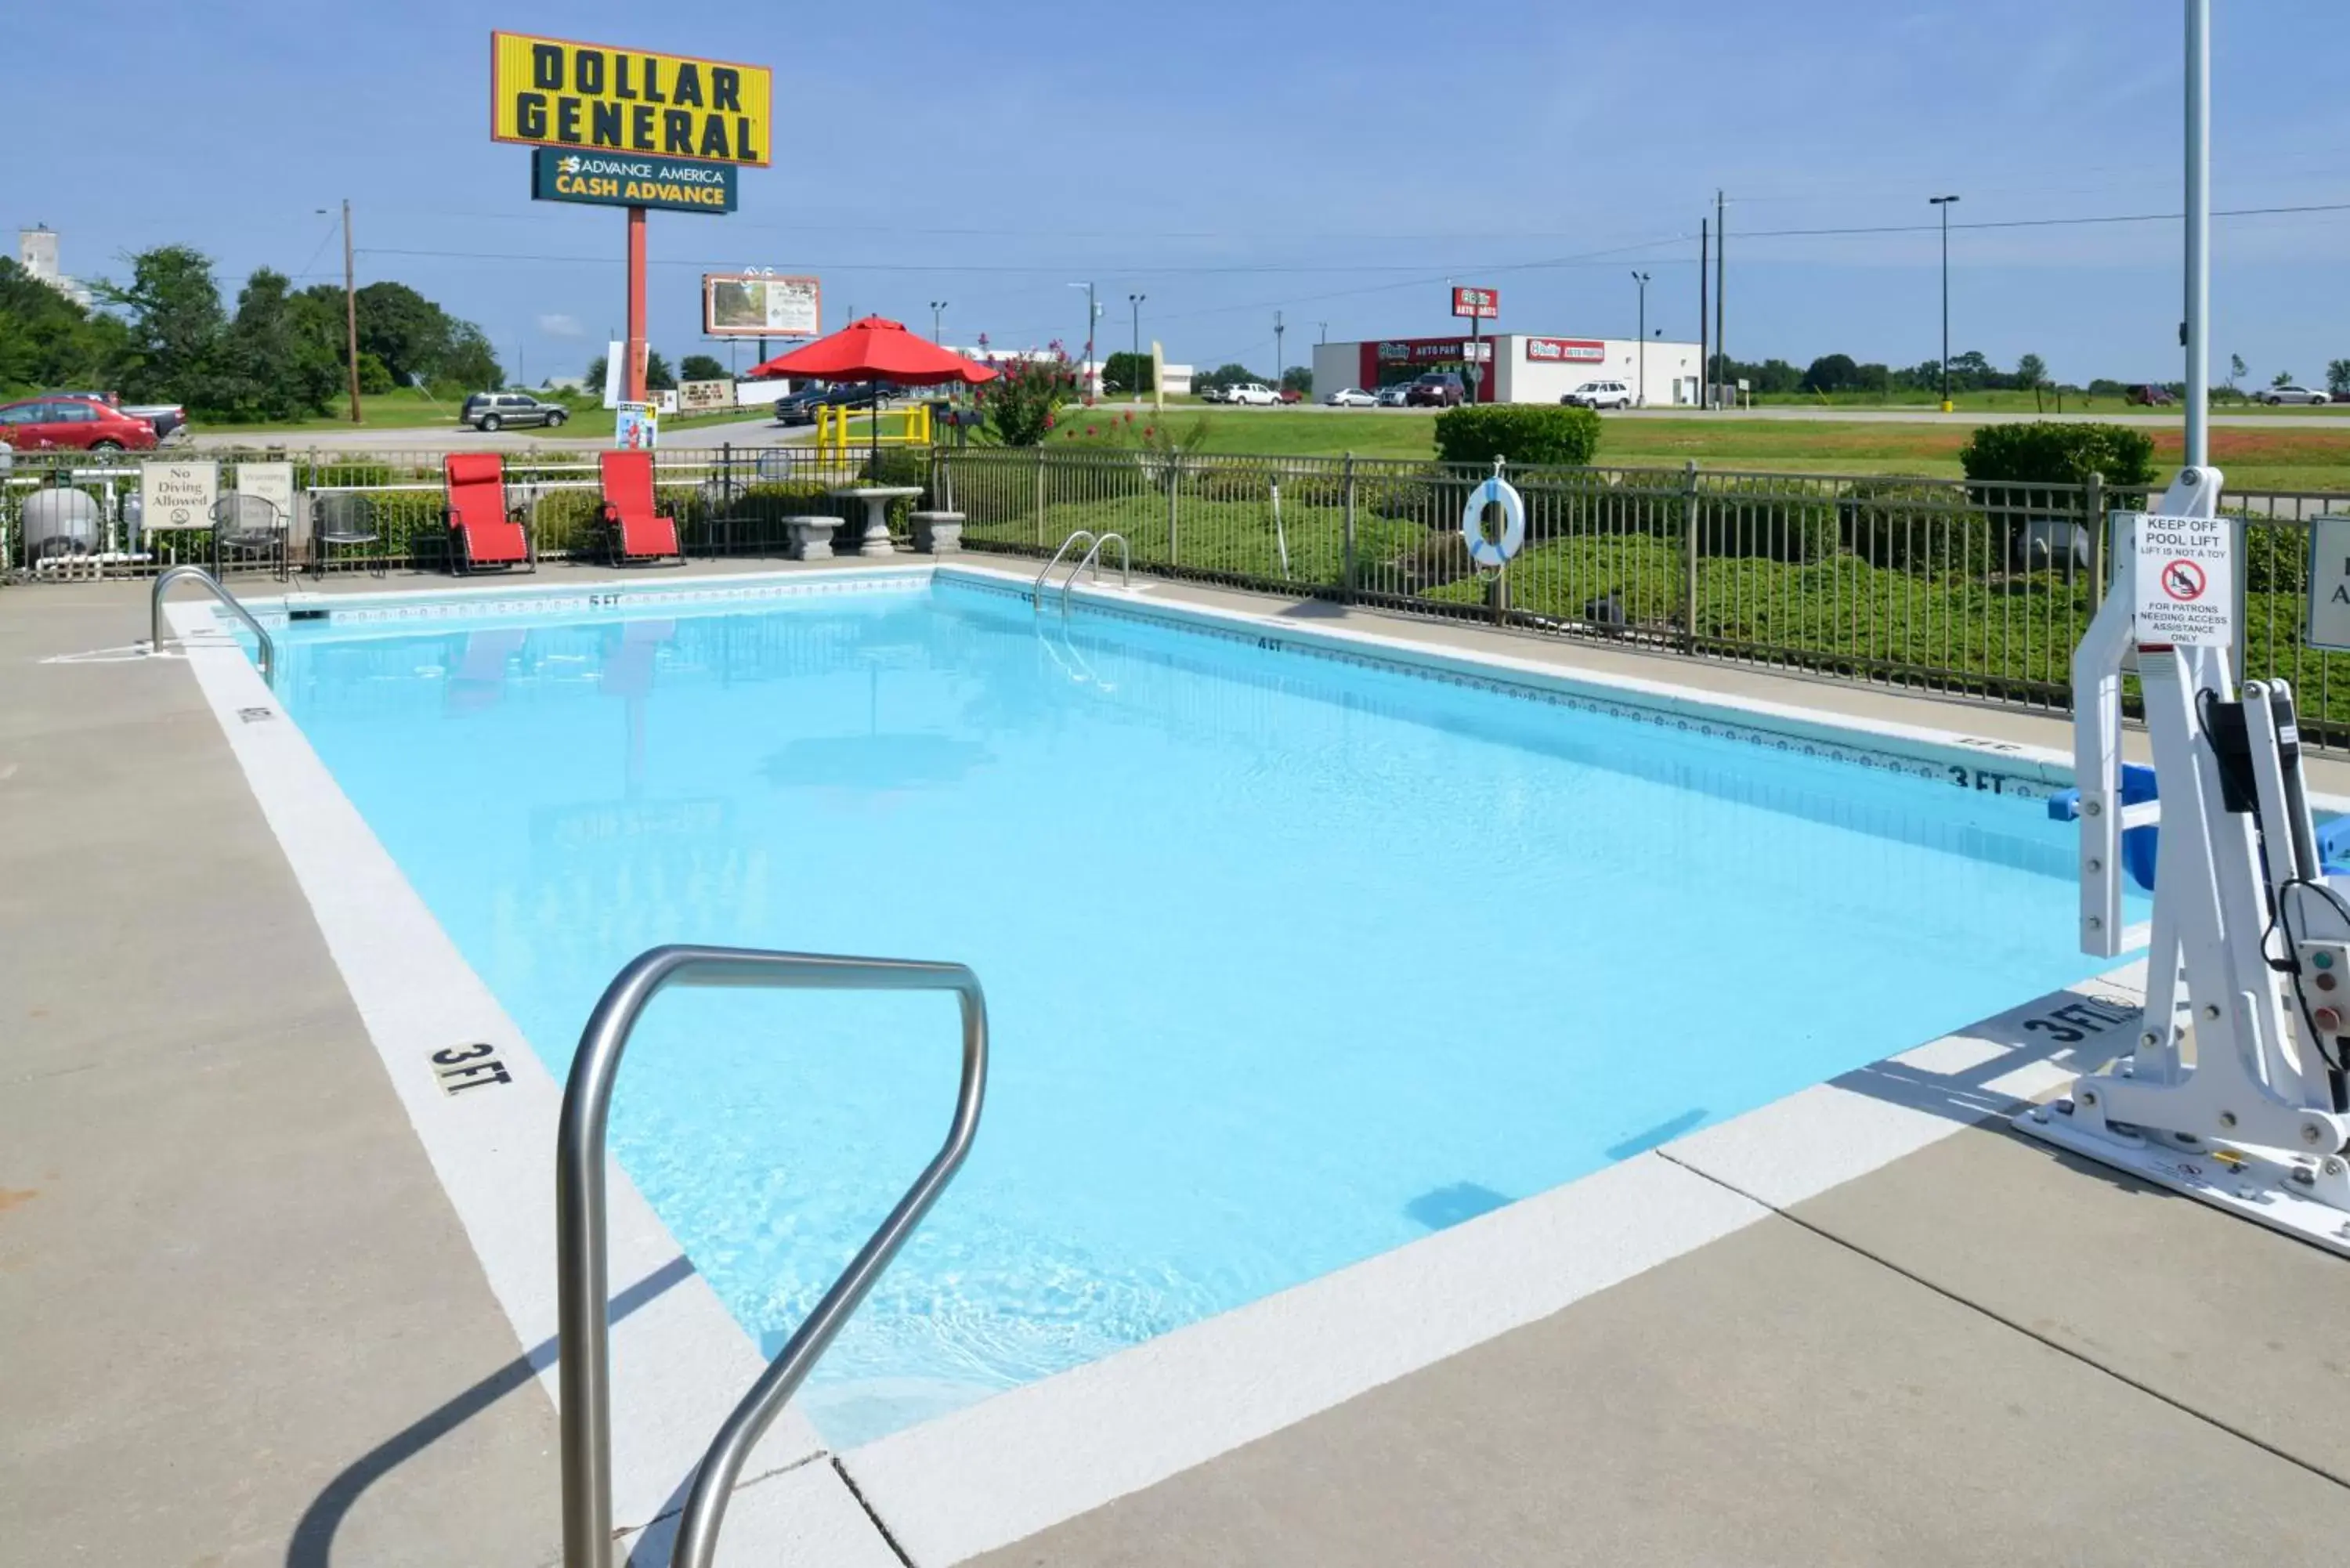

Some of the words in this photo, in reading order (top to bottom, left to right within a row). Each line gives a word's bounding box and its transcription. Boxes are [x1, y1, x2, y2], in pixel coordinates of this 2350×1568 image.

[533, 43, 741, 113] DOLLAR
[517, 92, 757, 161] GENERAL
[581, 160, 653, 178] ADVANCE
[659, 167, 725, 184] AMERICA
[556, 175, 618, 197] CASH
[624, 181, 725, 205] ADVANCE
[170, 469, 190, 478] No
[159, 480, 201, 495] Diving
[152, 495, 207, 507] Allowed
[2147, 518, 2186, 530] KEEP
[2189, 521, 2218, 532] OFF
[2146, 533, 2186, 546] POOL
[2190, 535, 2220, 547] LIFT
[2175, 548, 2195, 557] NOT
[2149, 602, 2170, 611] FOR
[2172, 604, 2218, 614] PATRONS
[2140, 612, 2185, 622] NEEDING
[2188, 614, 2227, 624] ACCESS
[2153, 623, 2215, 634] ASSISTANCE
[2171, 634, 2197, 642] ONLY
[1976, 770, 2007, 796] FT
